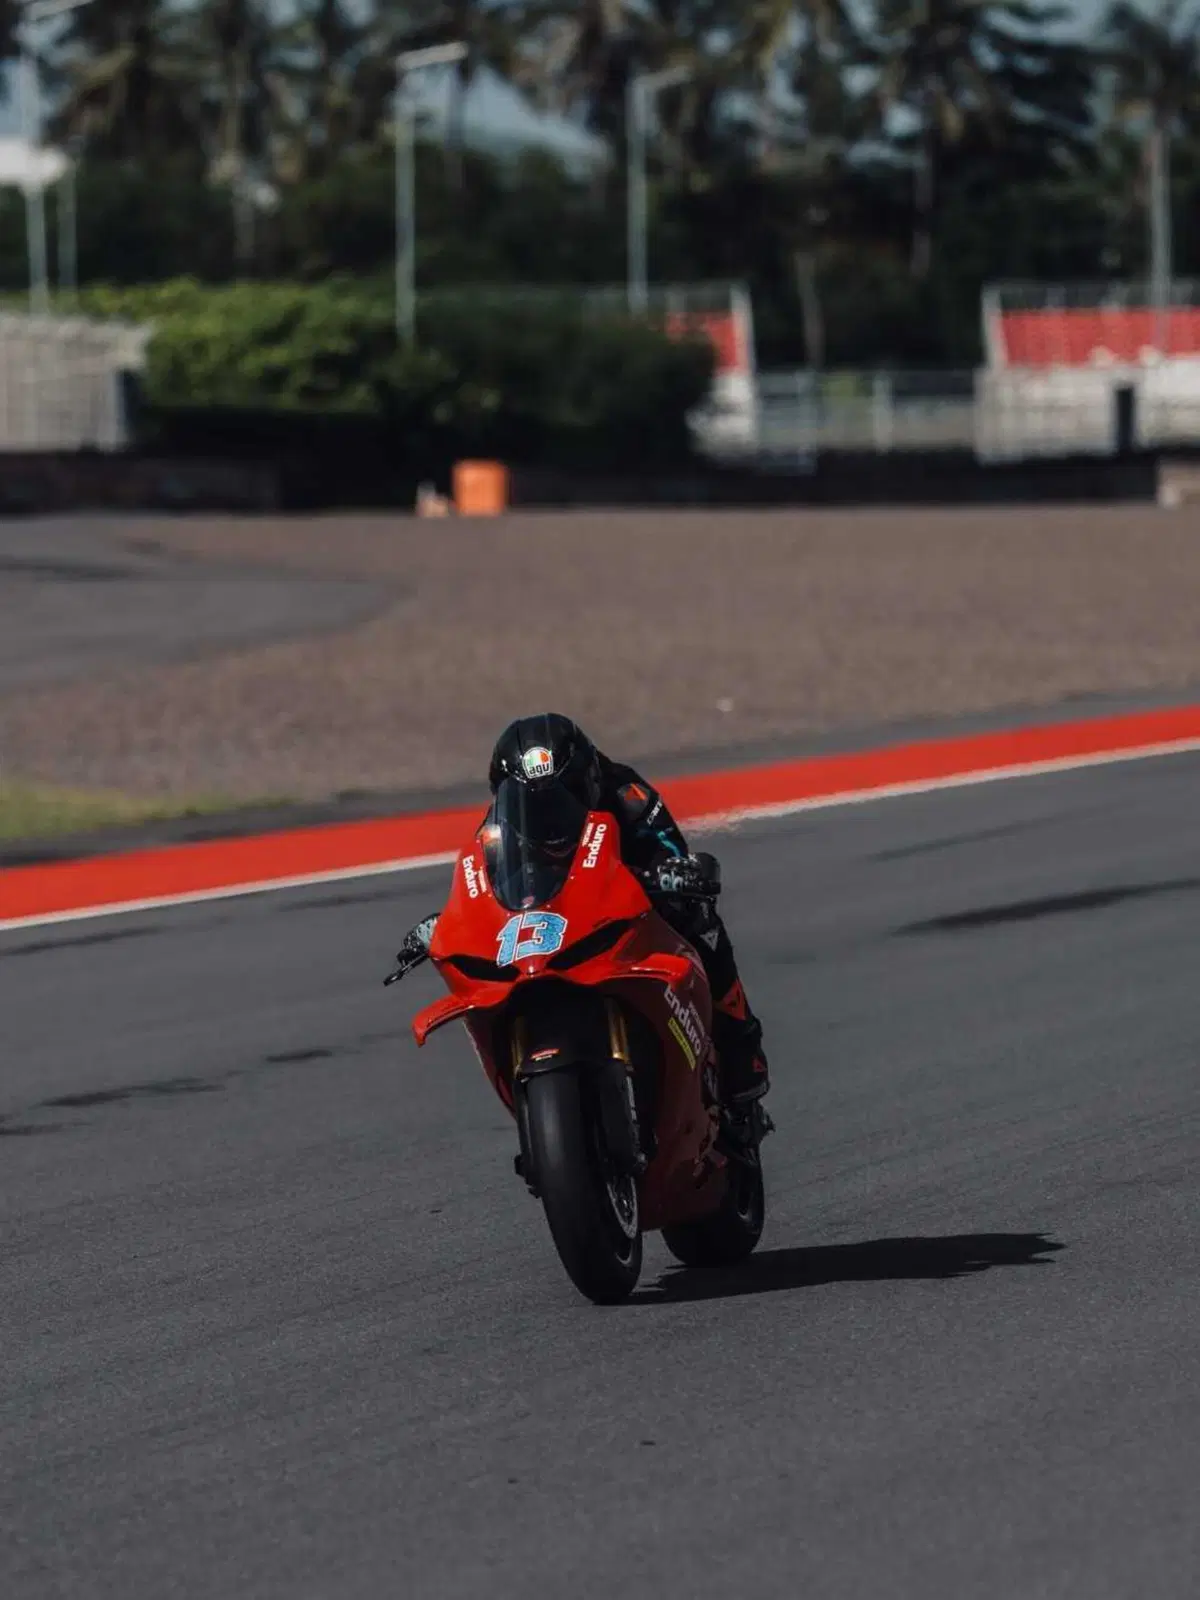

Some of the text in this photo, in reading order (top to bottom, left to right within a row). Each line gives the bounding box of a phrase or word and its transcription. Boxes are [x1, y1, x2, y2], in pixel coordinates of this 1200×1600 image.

[582, 823, 607, 868] Enduro
[463, 855, 479, 898] Enduro
[496, 911, 568, 967] 13
[664, 983, 701, 1057] Enduro
